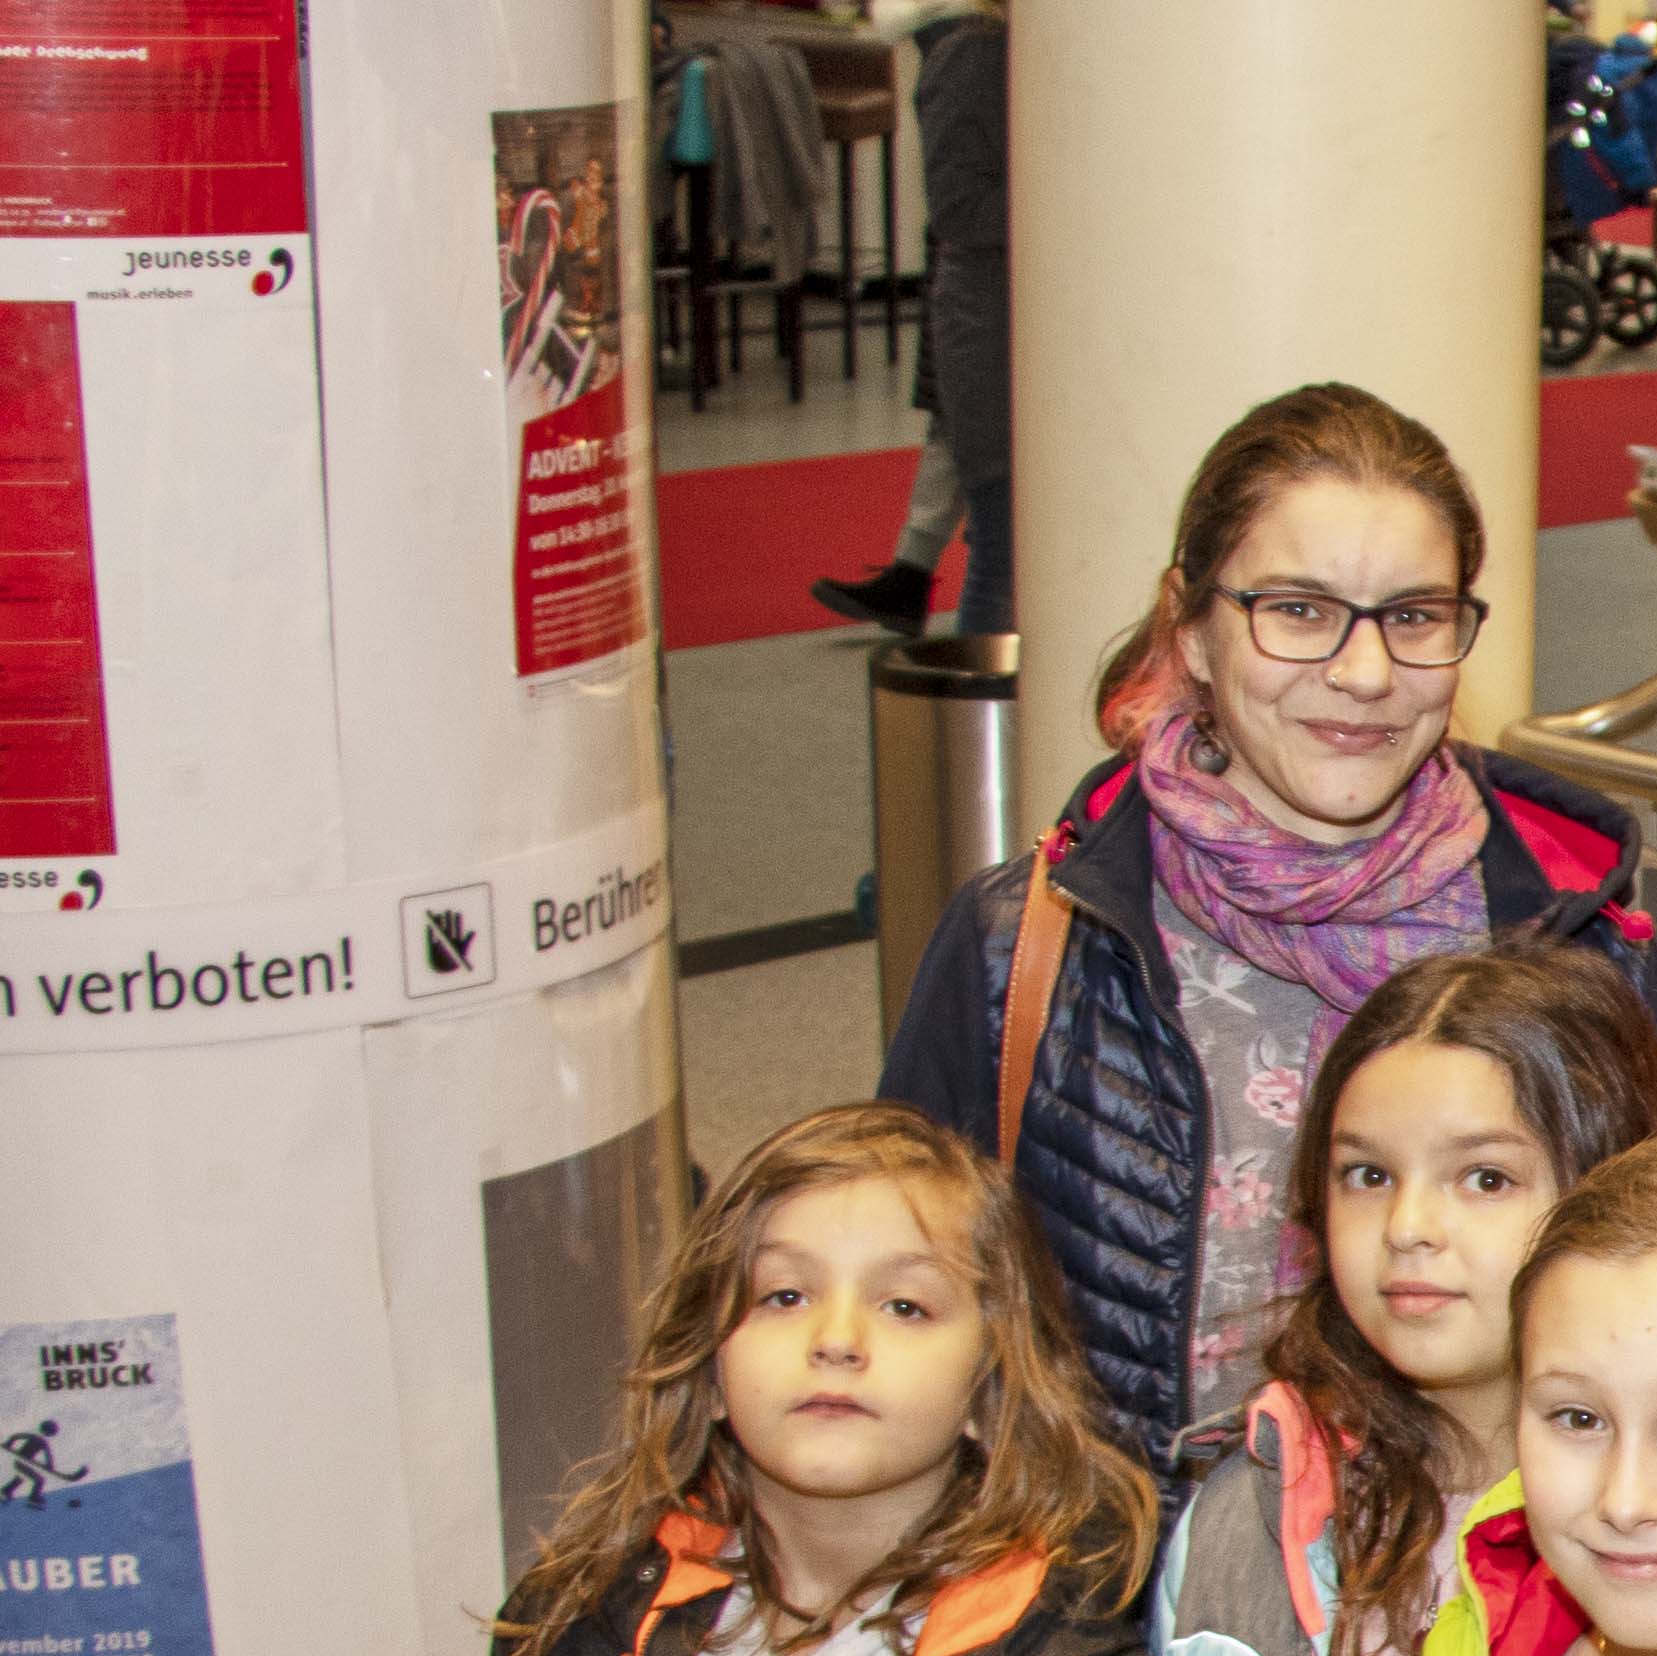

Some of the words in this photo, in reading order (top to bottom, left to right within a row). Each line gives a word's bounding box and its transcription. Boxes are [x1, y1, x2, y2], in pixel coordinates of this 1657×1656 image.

[122, 249, 252, 277] jeunesse
[38, 936, 355, 1018] verboten!
[43, 1362, 154, 1392] BRUCK
[93, 1629, 151, 1652] 2019
